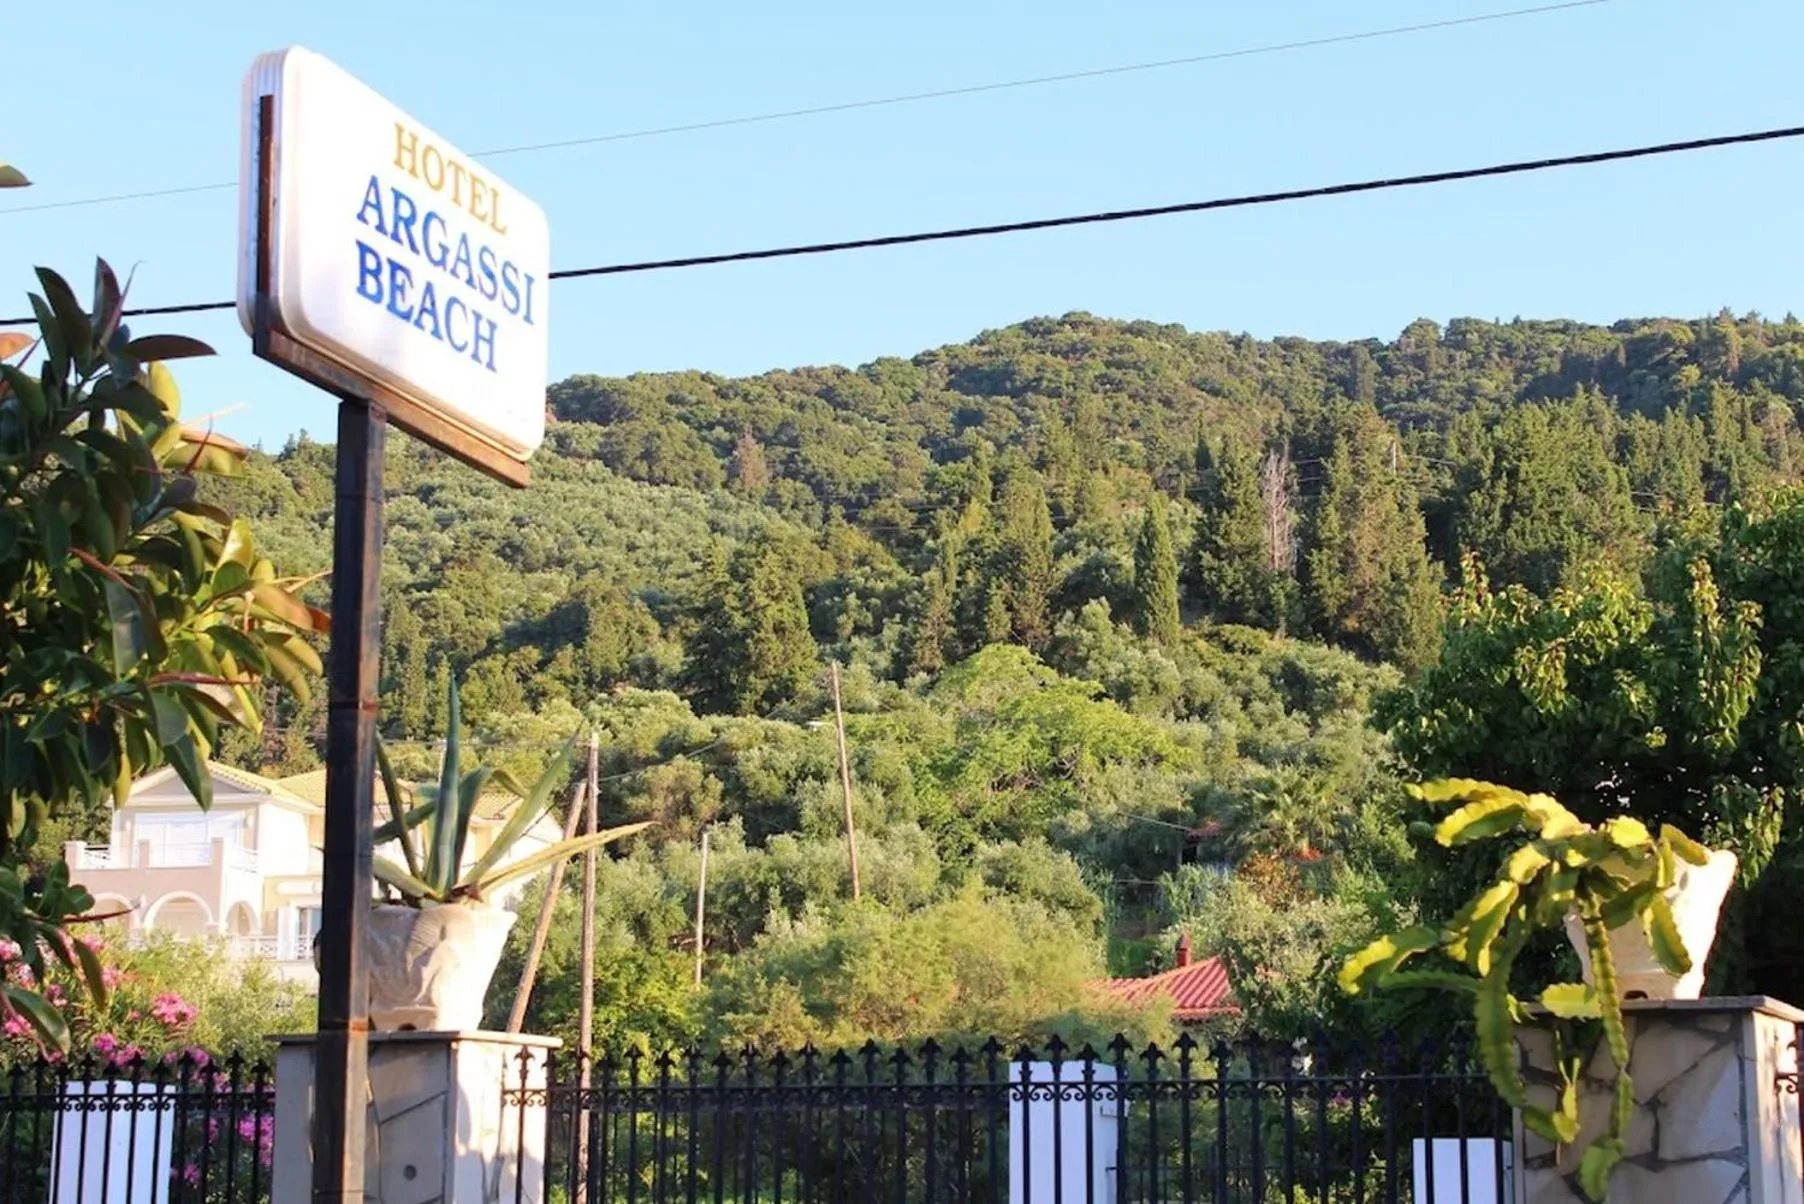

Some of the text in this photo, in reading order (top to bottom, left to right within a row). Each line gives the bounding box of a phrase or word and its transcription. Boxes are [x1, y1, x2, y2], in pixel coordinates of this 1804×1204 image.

[394, 122, 506, 236] HOTEL
[355, 239, 498, 373] BEACH
[356, 175, 535, 325] ARGASSI
